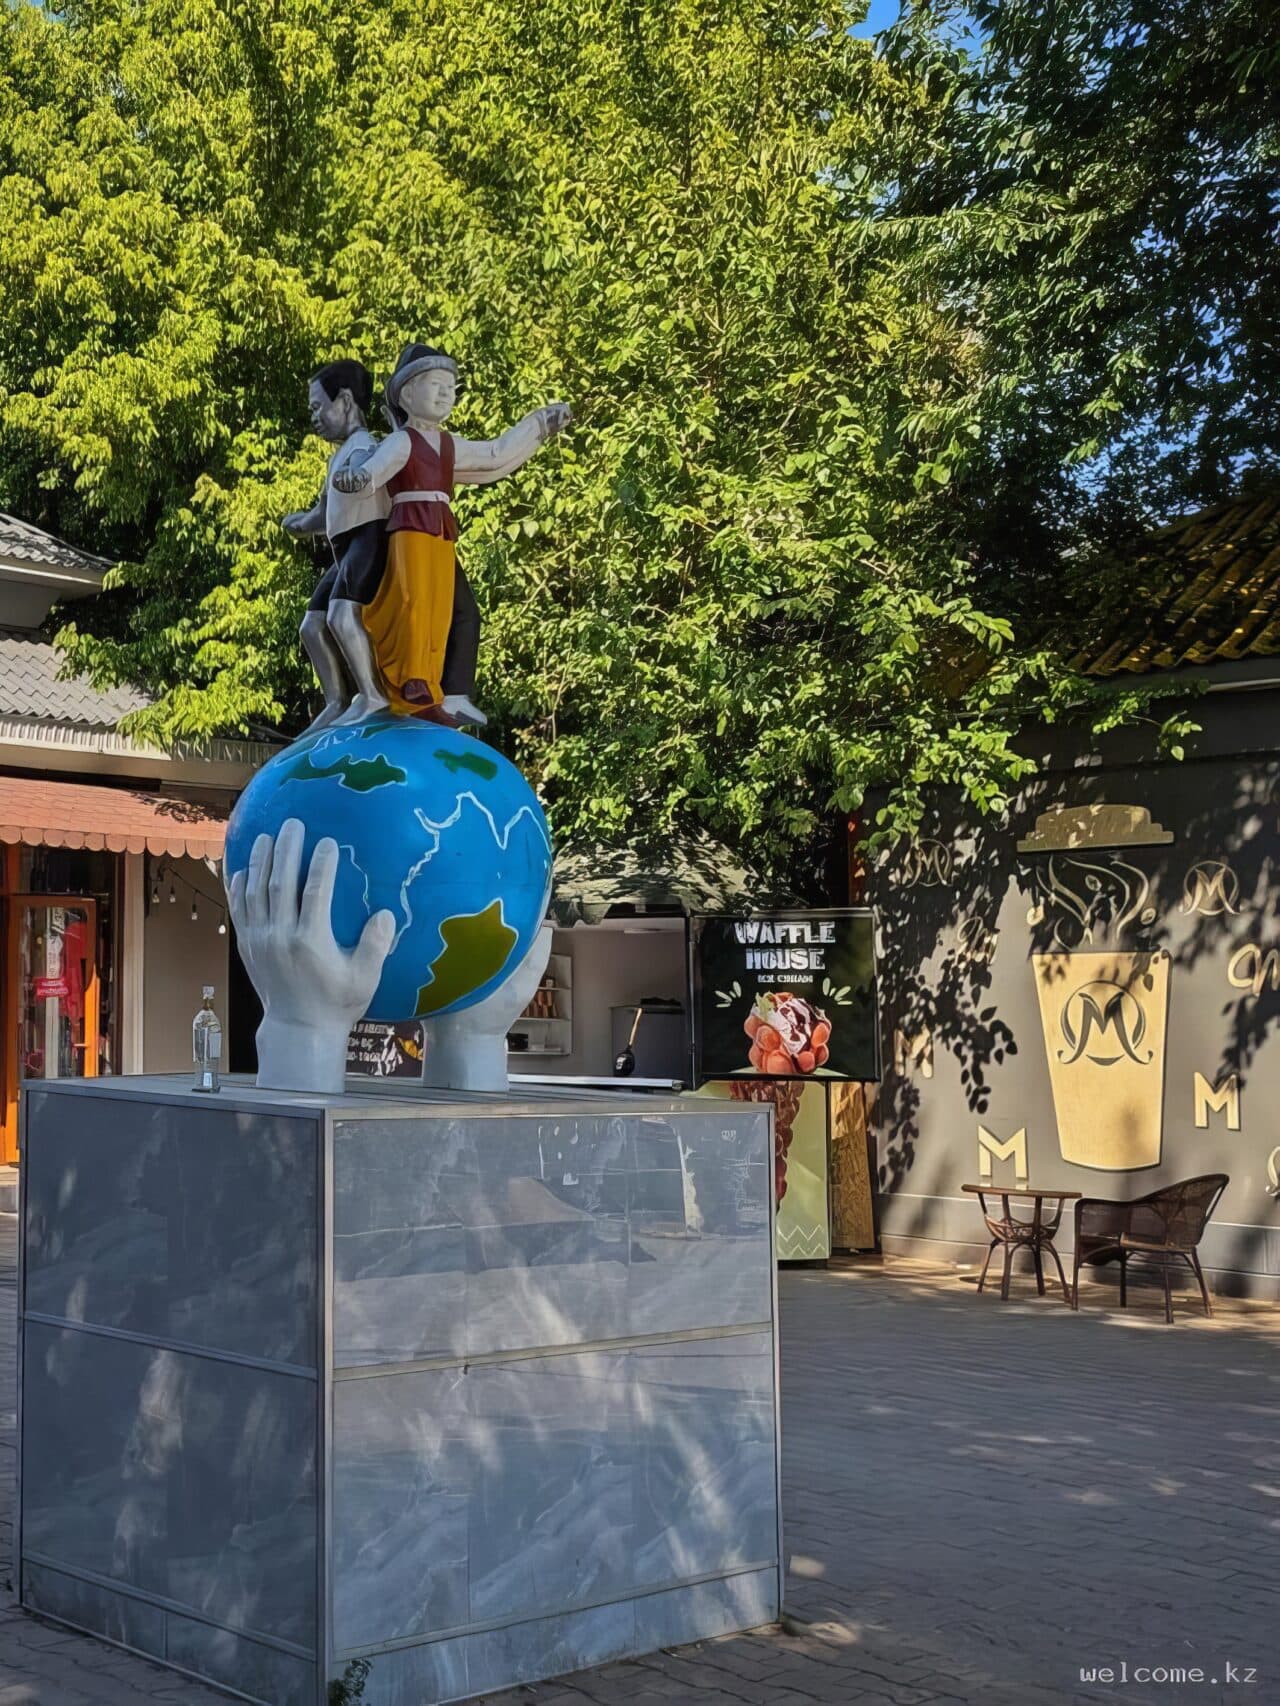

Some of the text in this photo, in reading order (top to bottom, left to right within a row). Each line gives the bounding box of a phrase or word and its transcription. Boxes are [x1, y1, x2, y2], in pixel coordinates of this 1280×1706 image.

[733, 920, 836, 944] WAFFLE
[745, 947, 826, 970] HOUSE
[1193, 1071, 1241, 1131] M
[977, 1123, 1029, 1181] M
